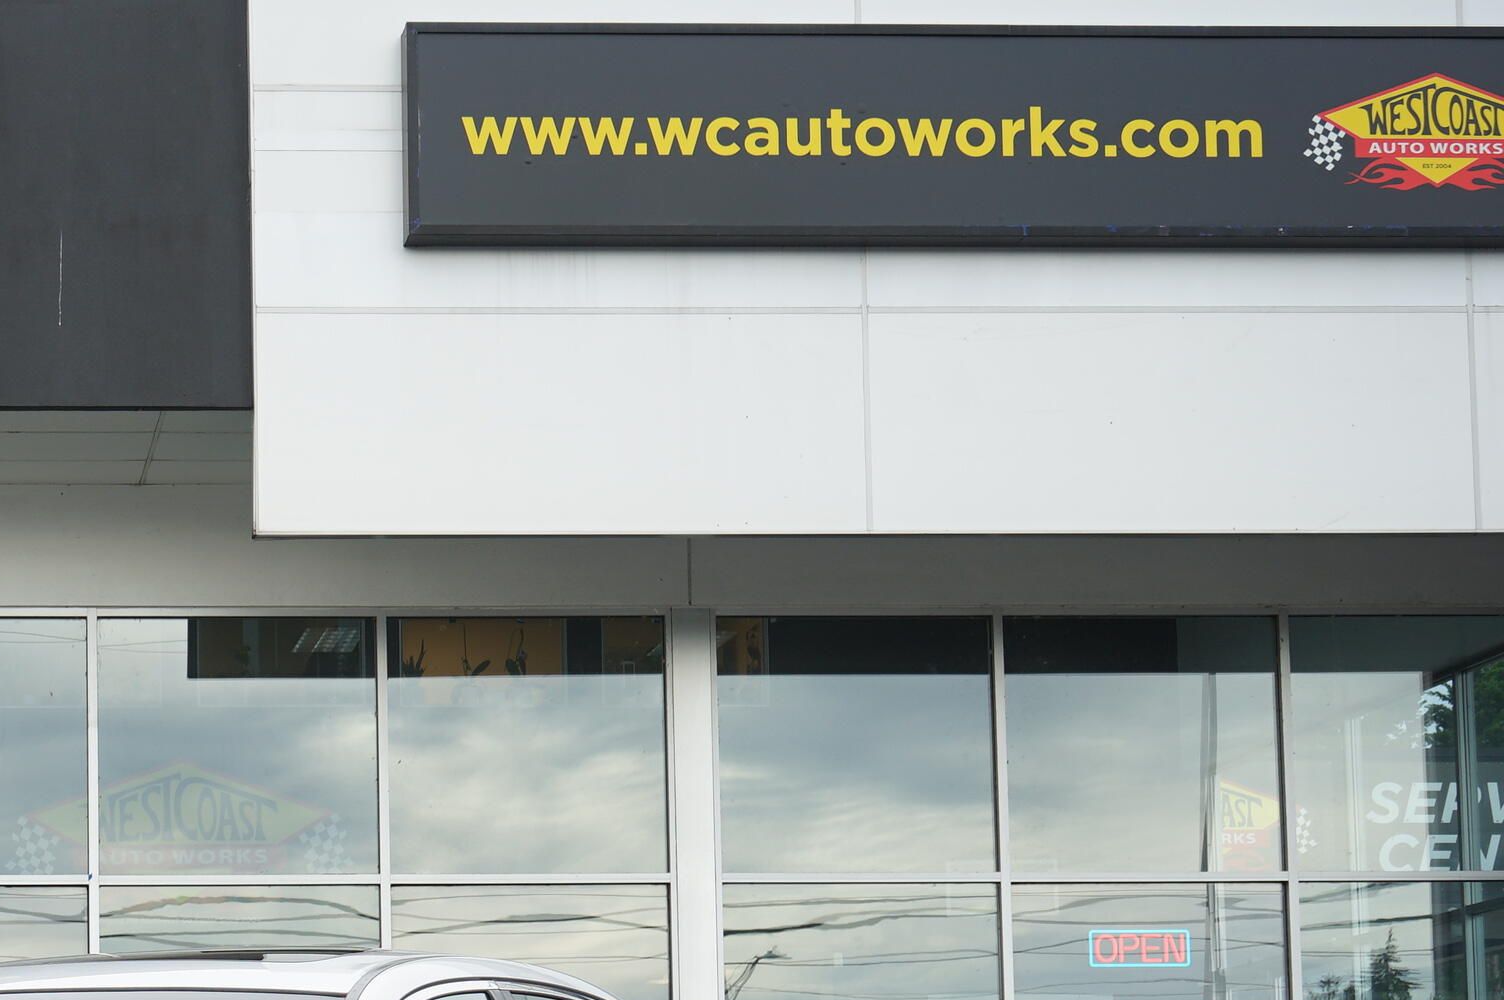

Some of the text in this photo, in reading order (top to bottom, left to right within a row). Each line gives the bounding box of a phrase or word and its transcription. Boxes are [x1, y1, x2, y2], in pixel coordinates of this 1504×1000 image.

[461, 106, 1264, 158] www.wcautoworks.com
[1368, 142, 1504, 154] AUTO WORKS
[172, 848, 269, 865] WORKS
[1094, 933, 1186, 963] OPEN
